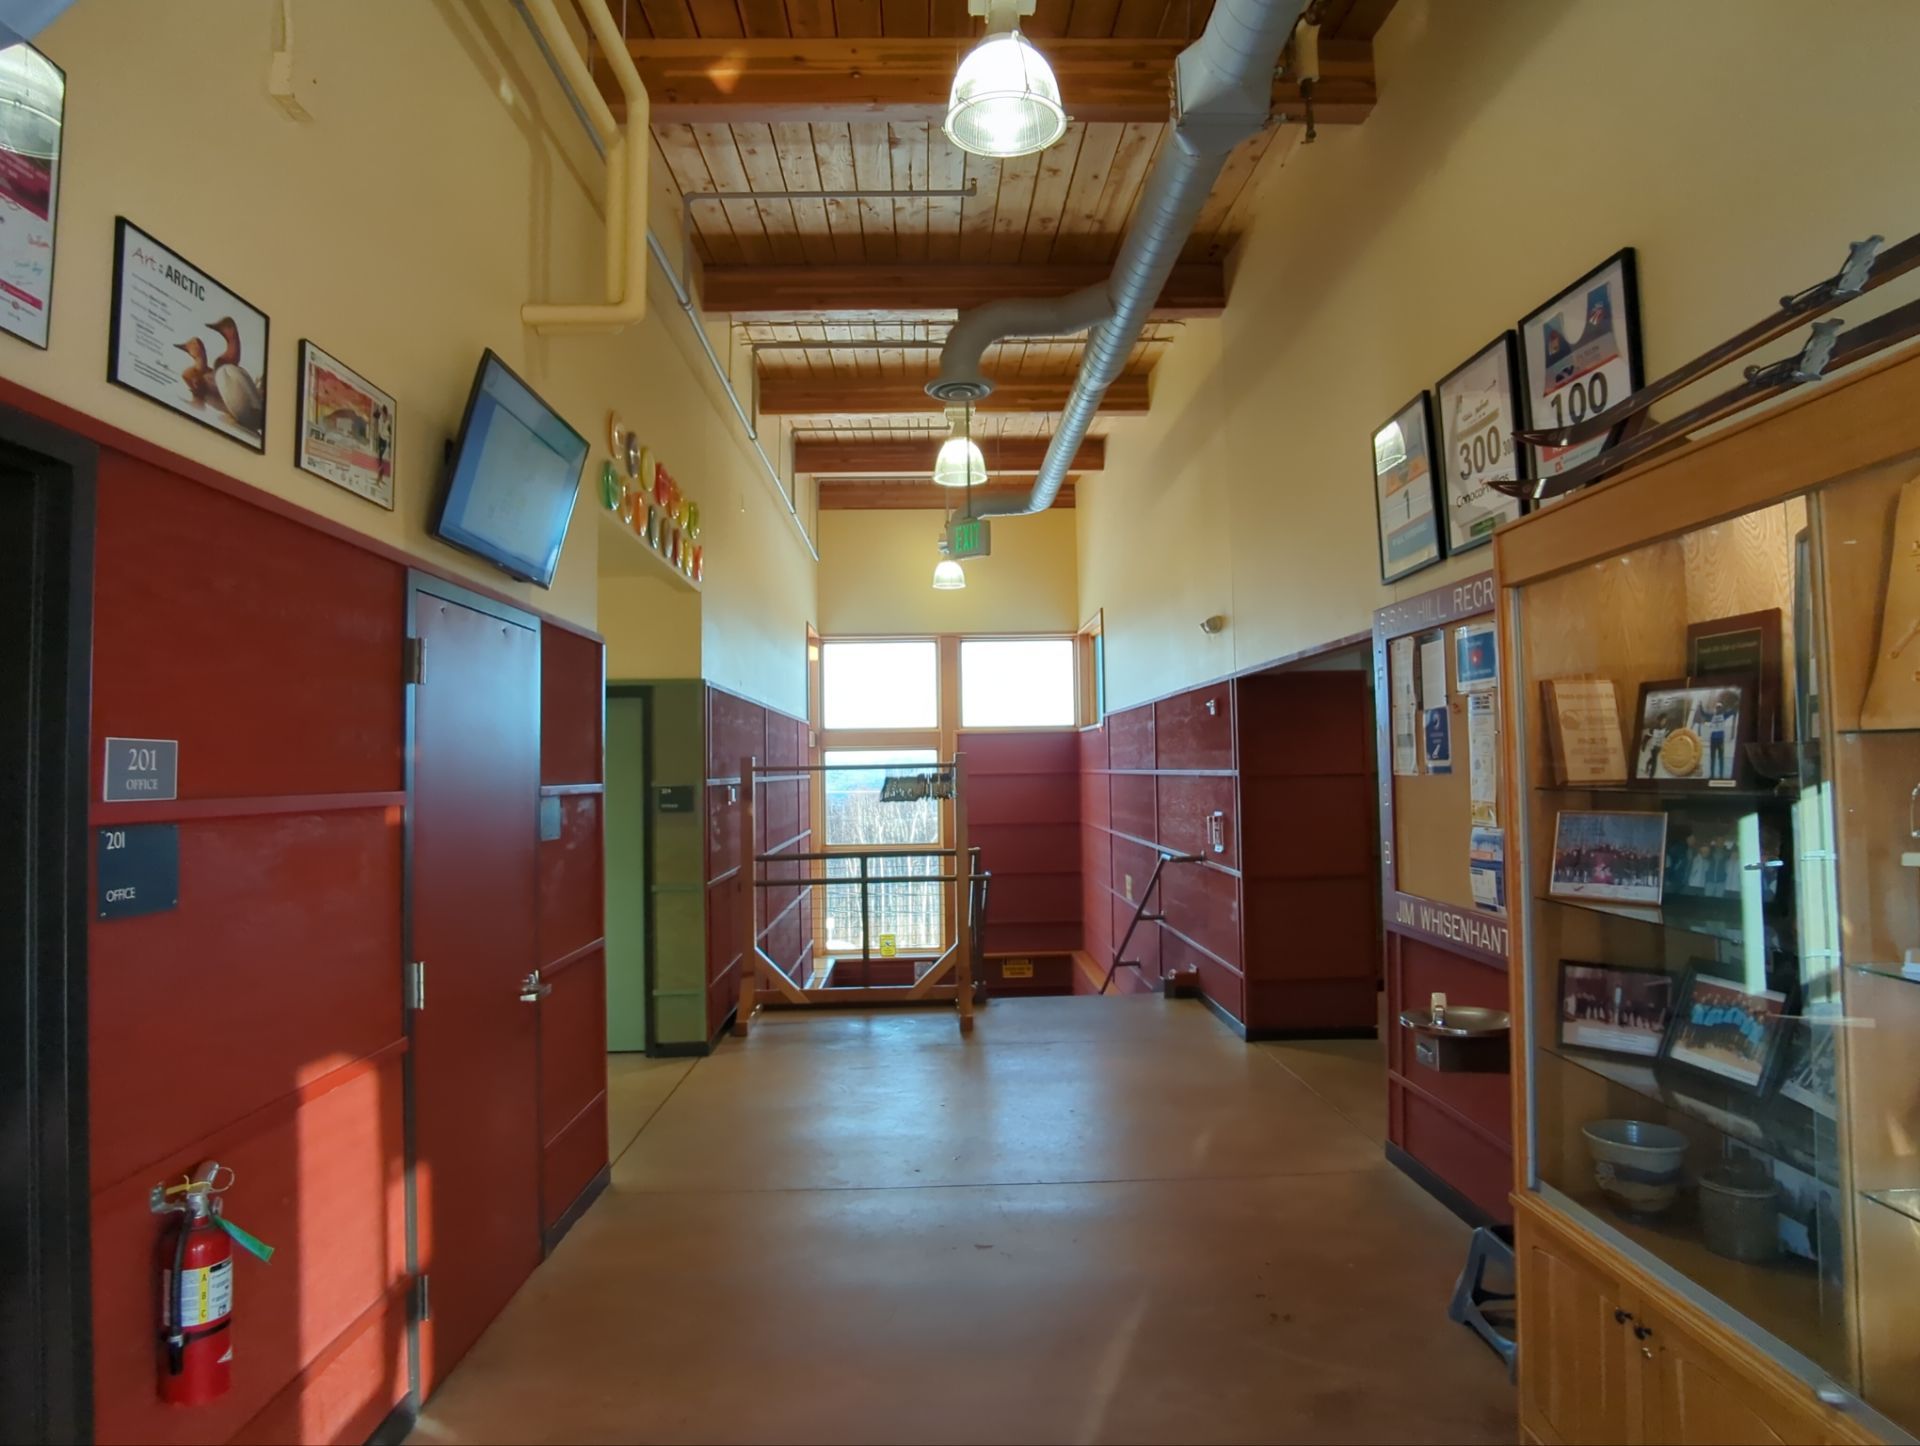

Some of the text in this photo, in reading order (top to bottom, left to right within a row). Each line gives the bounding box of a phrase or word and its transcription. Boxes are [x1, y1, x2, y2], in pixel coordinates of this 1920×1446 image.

[132, 247, 156, 272] Art
[165, 264, 206, 302] ARCTIC
[1551, 371, 1608, 429] 100
[1460, 425, 1500, 480] 300
[955, 522, 979, 553] EXIT
[128, 749, 157, 771] 201
[126, 778, 158, 791] OFFICE
[106, 831, 125, 850] 201
[106, 887, 136, 902] OFFICE
[1396, 901, 1509, 957] JIM WHISENHANT
